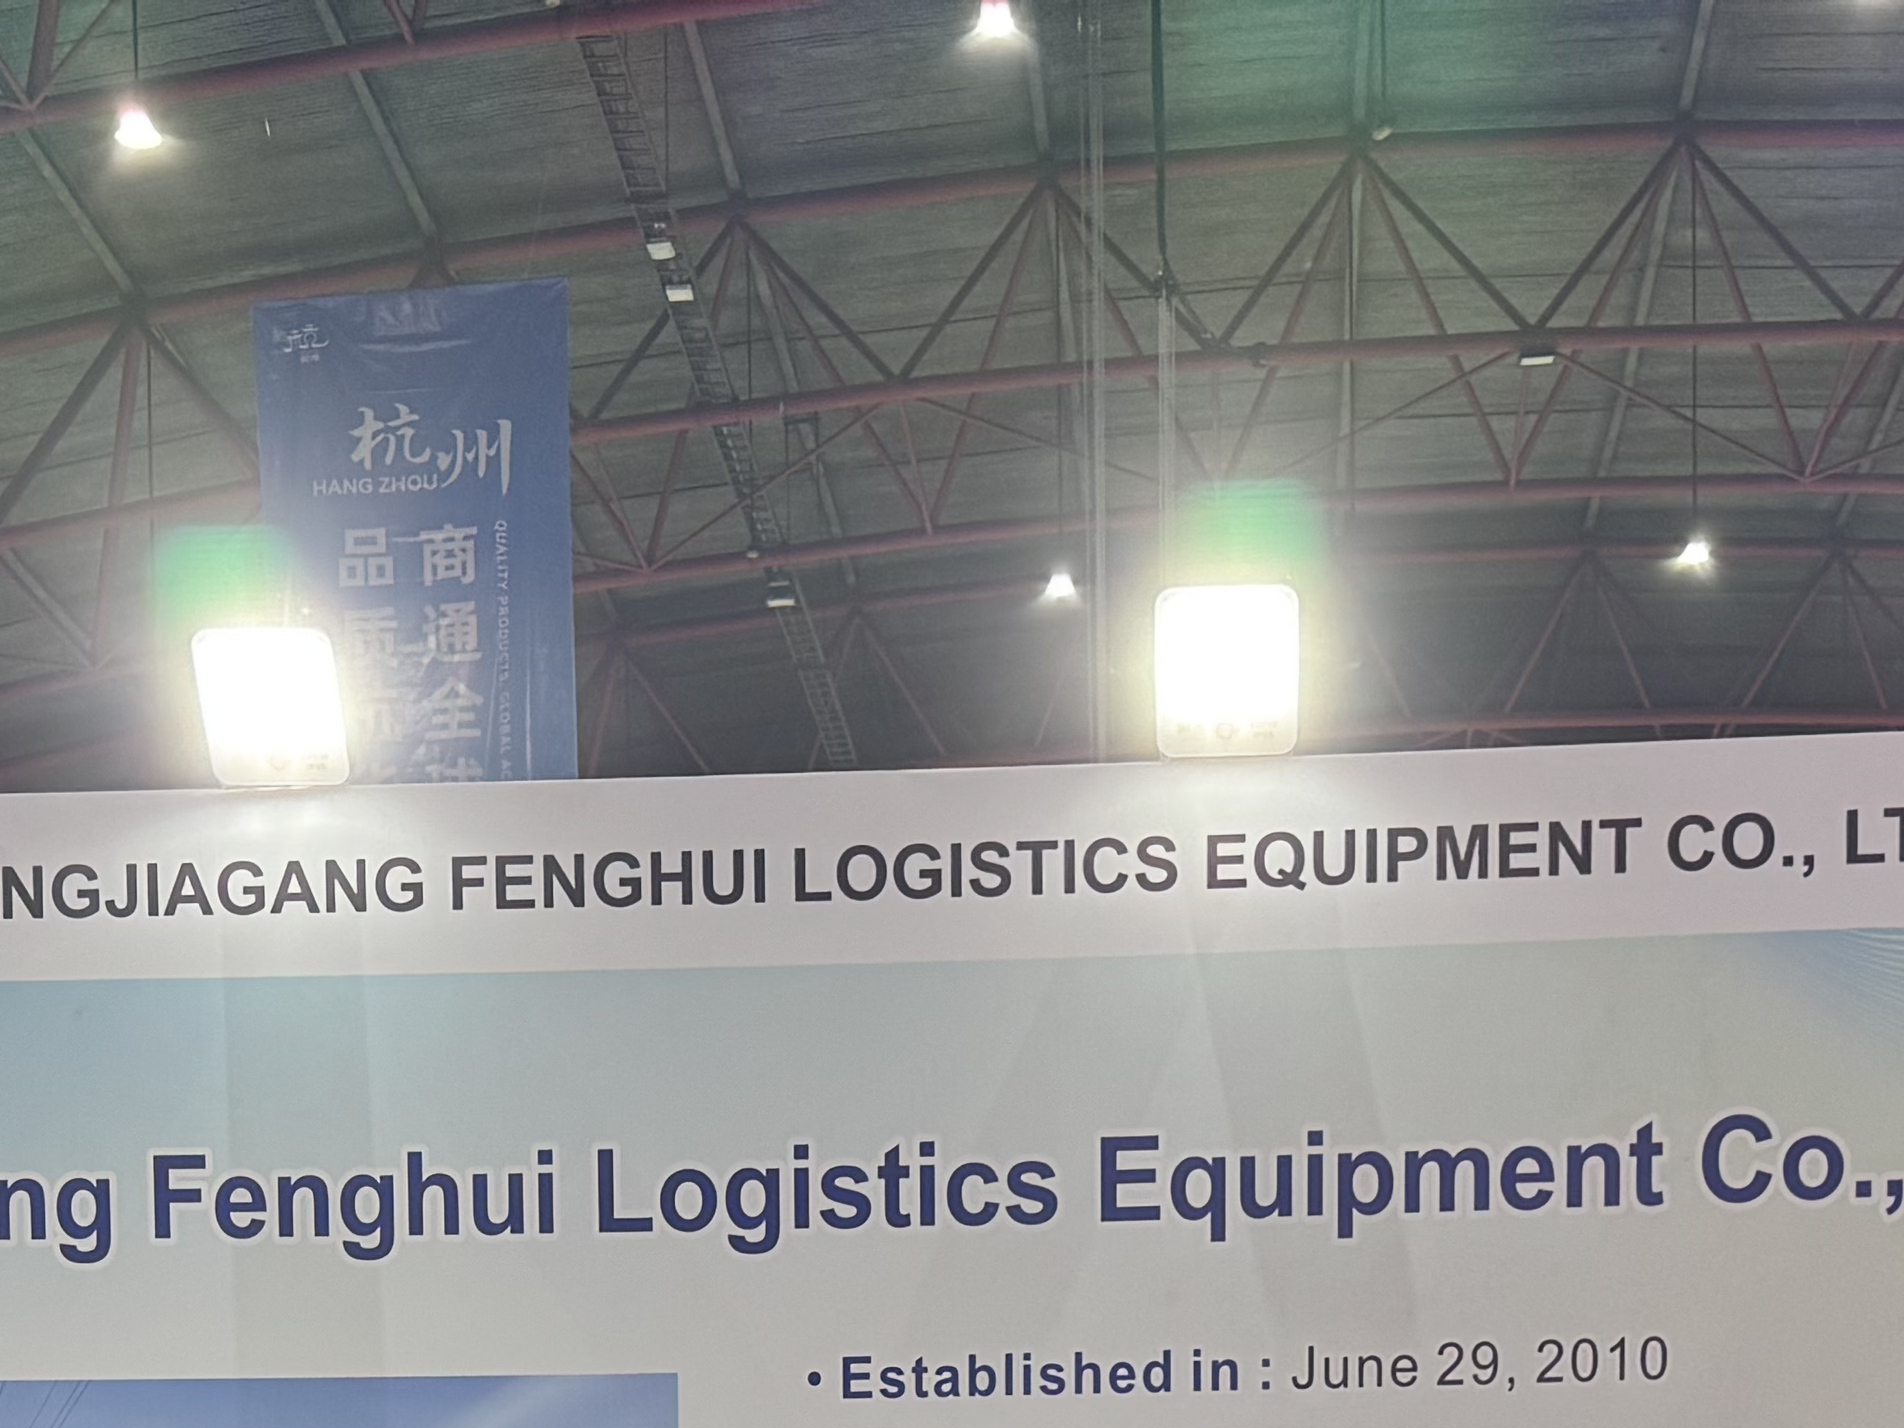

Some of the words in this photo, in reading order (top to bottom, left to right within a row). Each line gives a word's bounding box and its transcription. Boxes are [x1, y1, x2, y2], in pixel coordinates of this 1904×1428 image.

[312, 478, 373, 498] HANG
[378, 473, 439, 494] ZHOU
[348, 402, 513, 496] 杭州
[451, 847, 767, 911] FENGHUI
[793, 835, 1178, 904] LOGISTICS
[1206, 816, 1643, 892] EQUIPMENT
[1666, 811, 1817, 882] CO.,
[152, 1148, 555, 1261] Fenghui
[597, 1140, 1058, 1255] Logistics
[1100, 1120, 1664, 1243] Equipment
[841, 1348, 1172, 1400] Established
[1192, 1348, 1239, 1392] in
[1291, 1345, 1419, 1391] June
[1436, 1341, 1517, 1393] 29,
[1535, 1335, 1670, 1385] 2010
